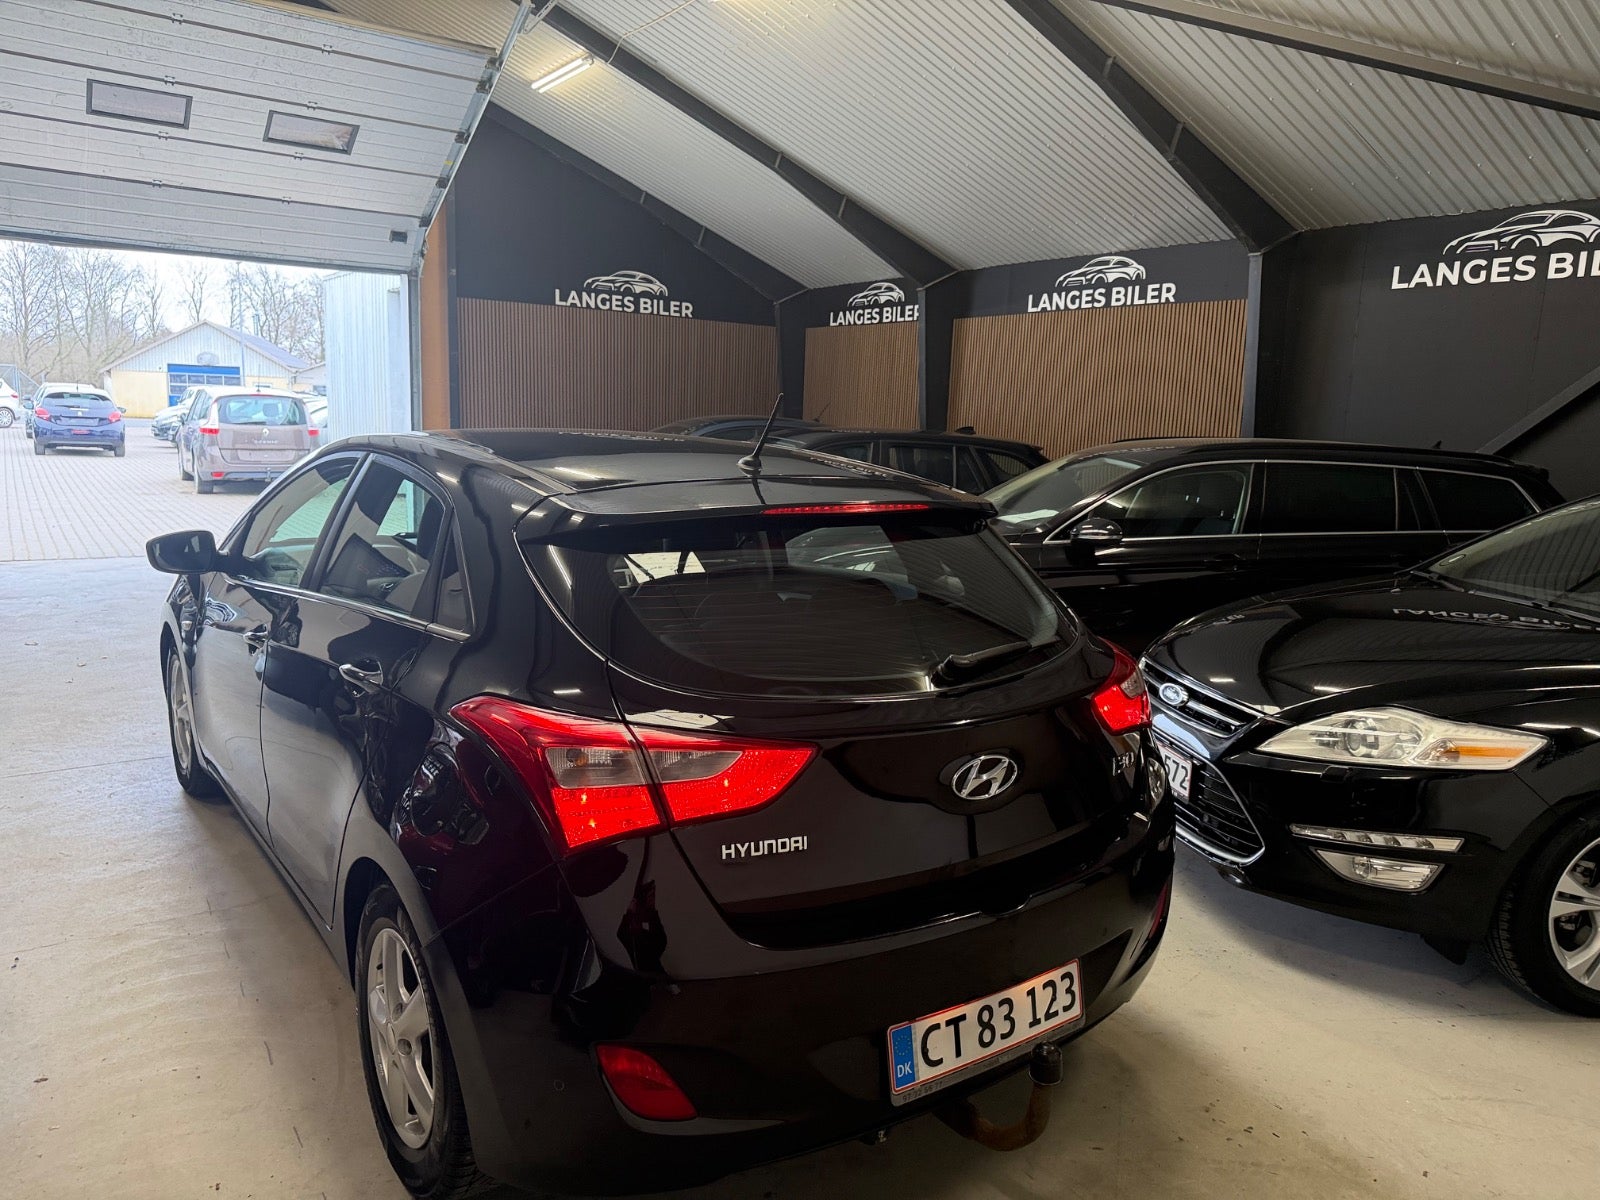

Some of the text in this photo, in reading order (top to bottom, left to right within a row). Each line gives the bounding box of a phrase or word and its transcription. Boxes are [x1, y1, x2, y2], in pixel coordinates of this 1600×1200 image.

[1391, 255, 1537, 290] LANGES
[554, 288, 694, 318] LANGES BILER
[1027, 282, 1177, 313] LANGES BILER
[829, 307, 880, 327] LANGES
[721, 835, 808, 860] HYUNDAI
[920, 971, 1077, 1068] CT 83 123
[896, 1060, 913, 1078] DK
